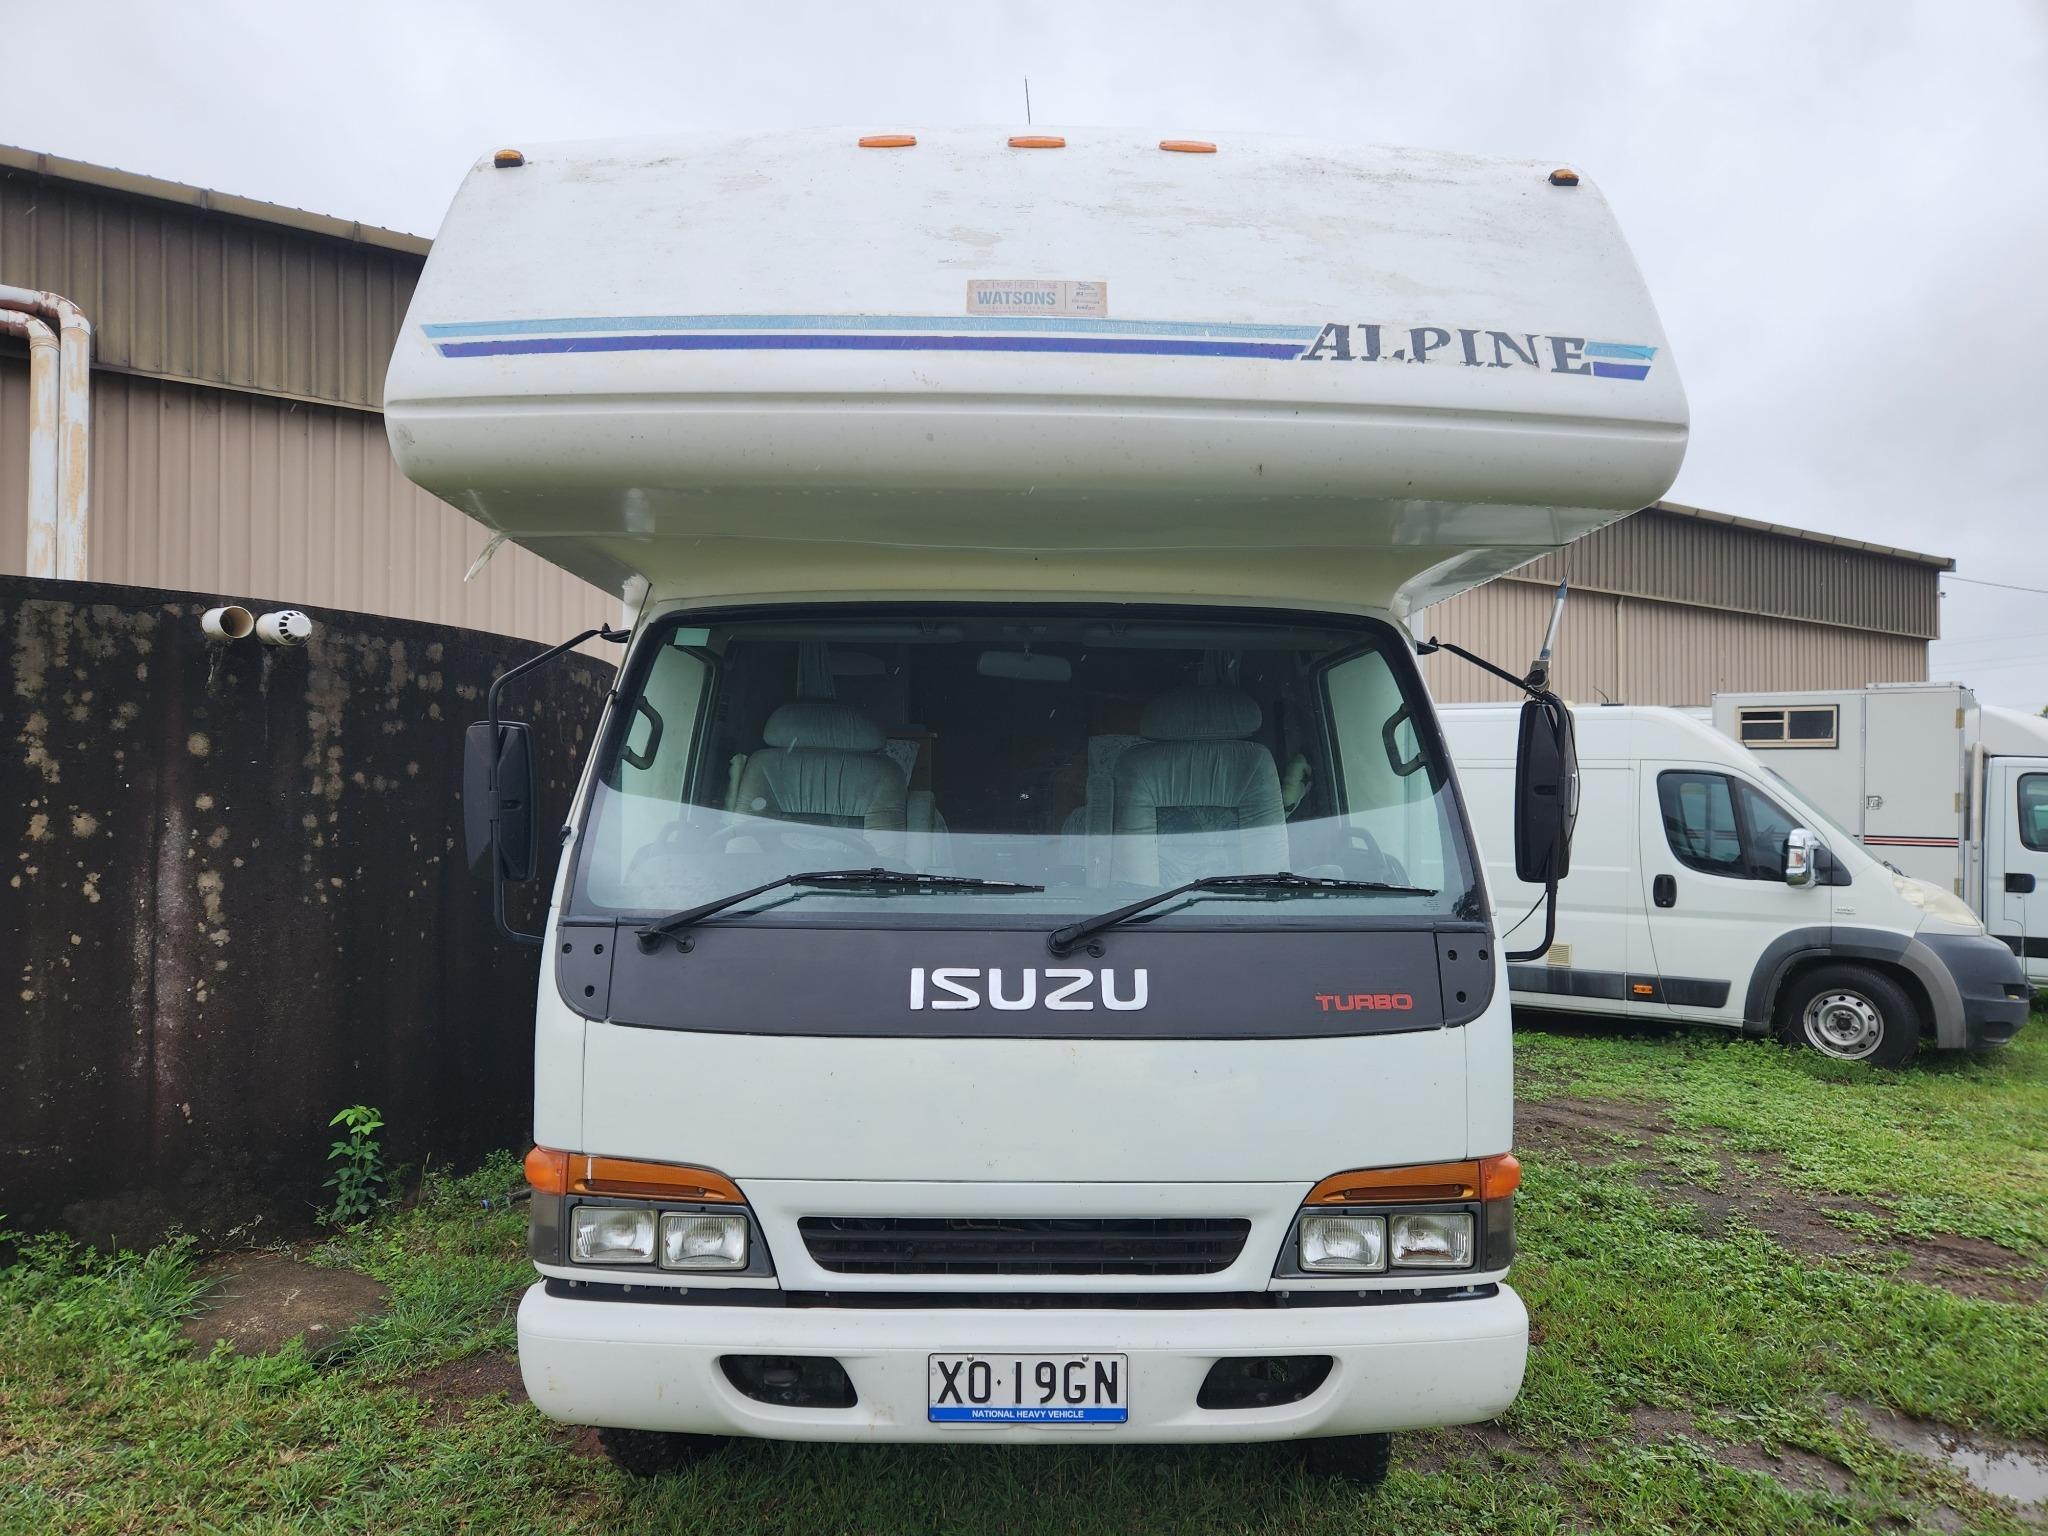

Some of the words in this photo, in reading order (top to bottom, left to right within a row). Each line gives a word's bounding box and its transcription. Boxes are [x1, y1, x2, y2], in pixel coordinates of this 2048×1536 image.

[977, 290, 1056, 305] WATSONS
[1301, 323, 1591, 376] ALPINE
[909, 967, 1148, 1011] ISUZU
[1315, 993, 1414, 1010] TURBO
[971, 1409, 1015, 1419] NATIONAL
[1016, 1410, 1046, 1419] HEAVY
[1047, 1410, 1084, 1418] VEHICLE
